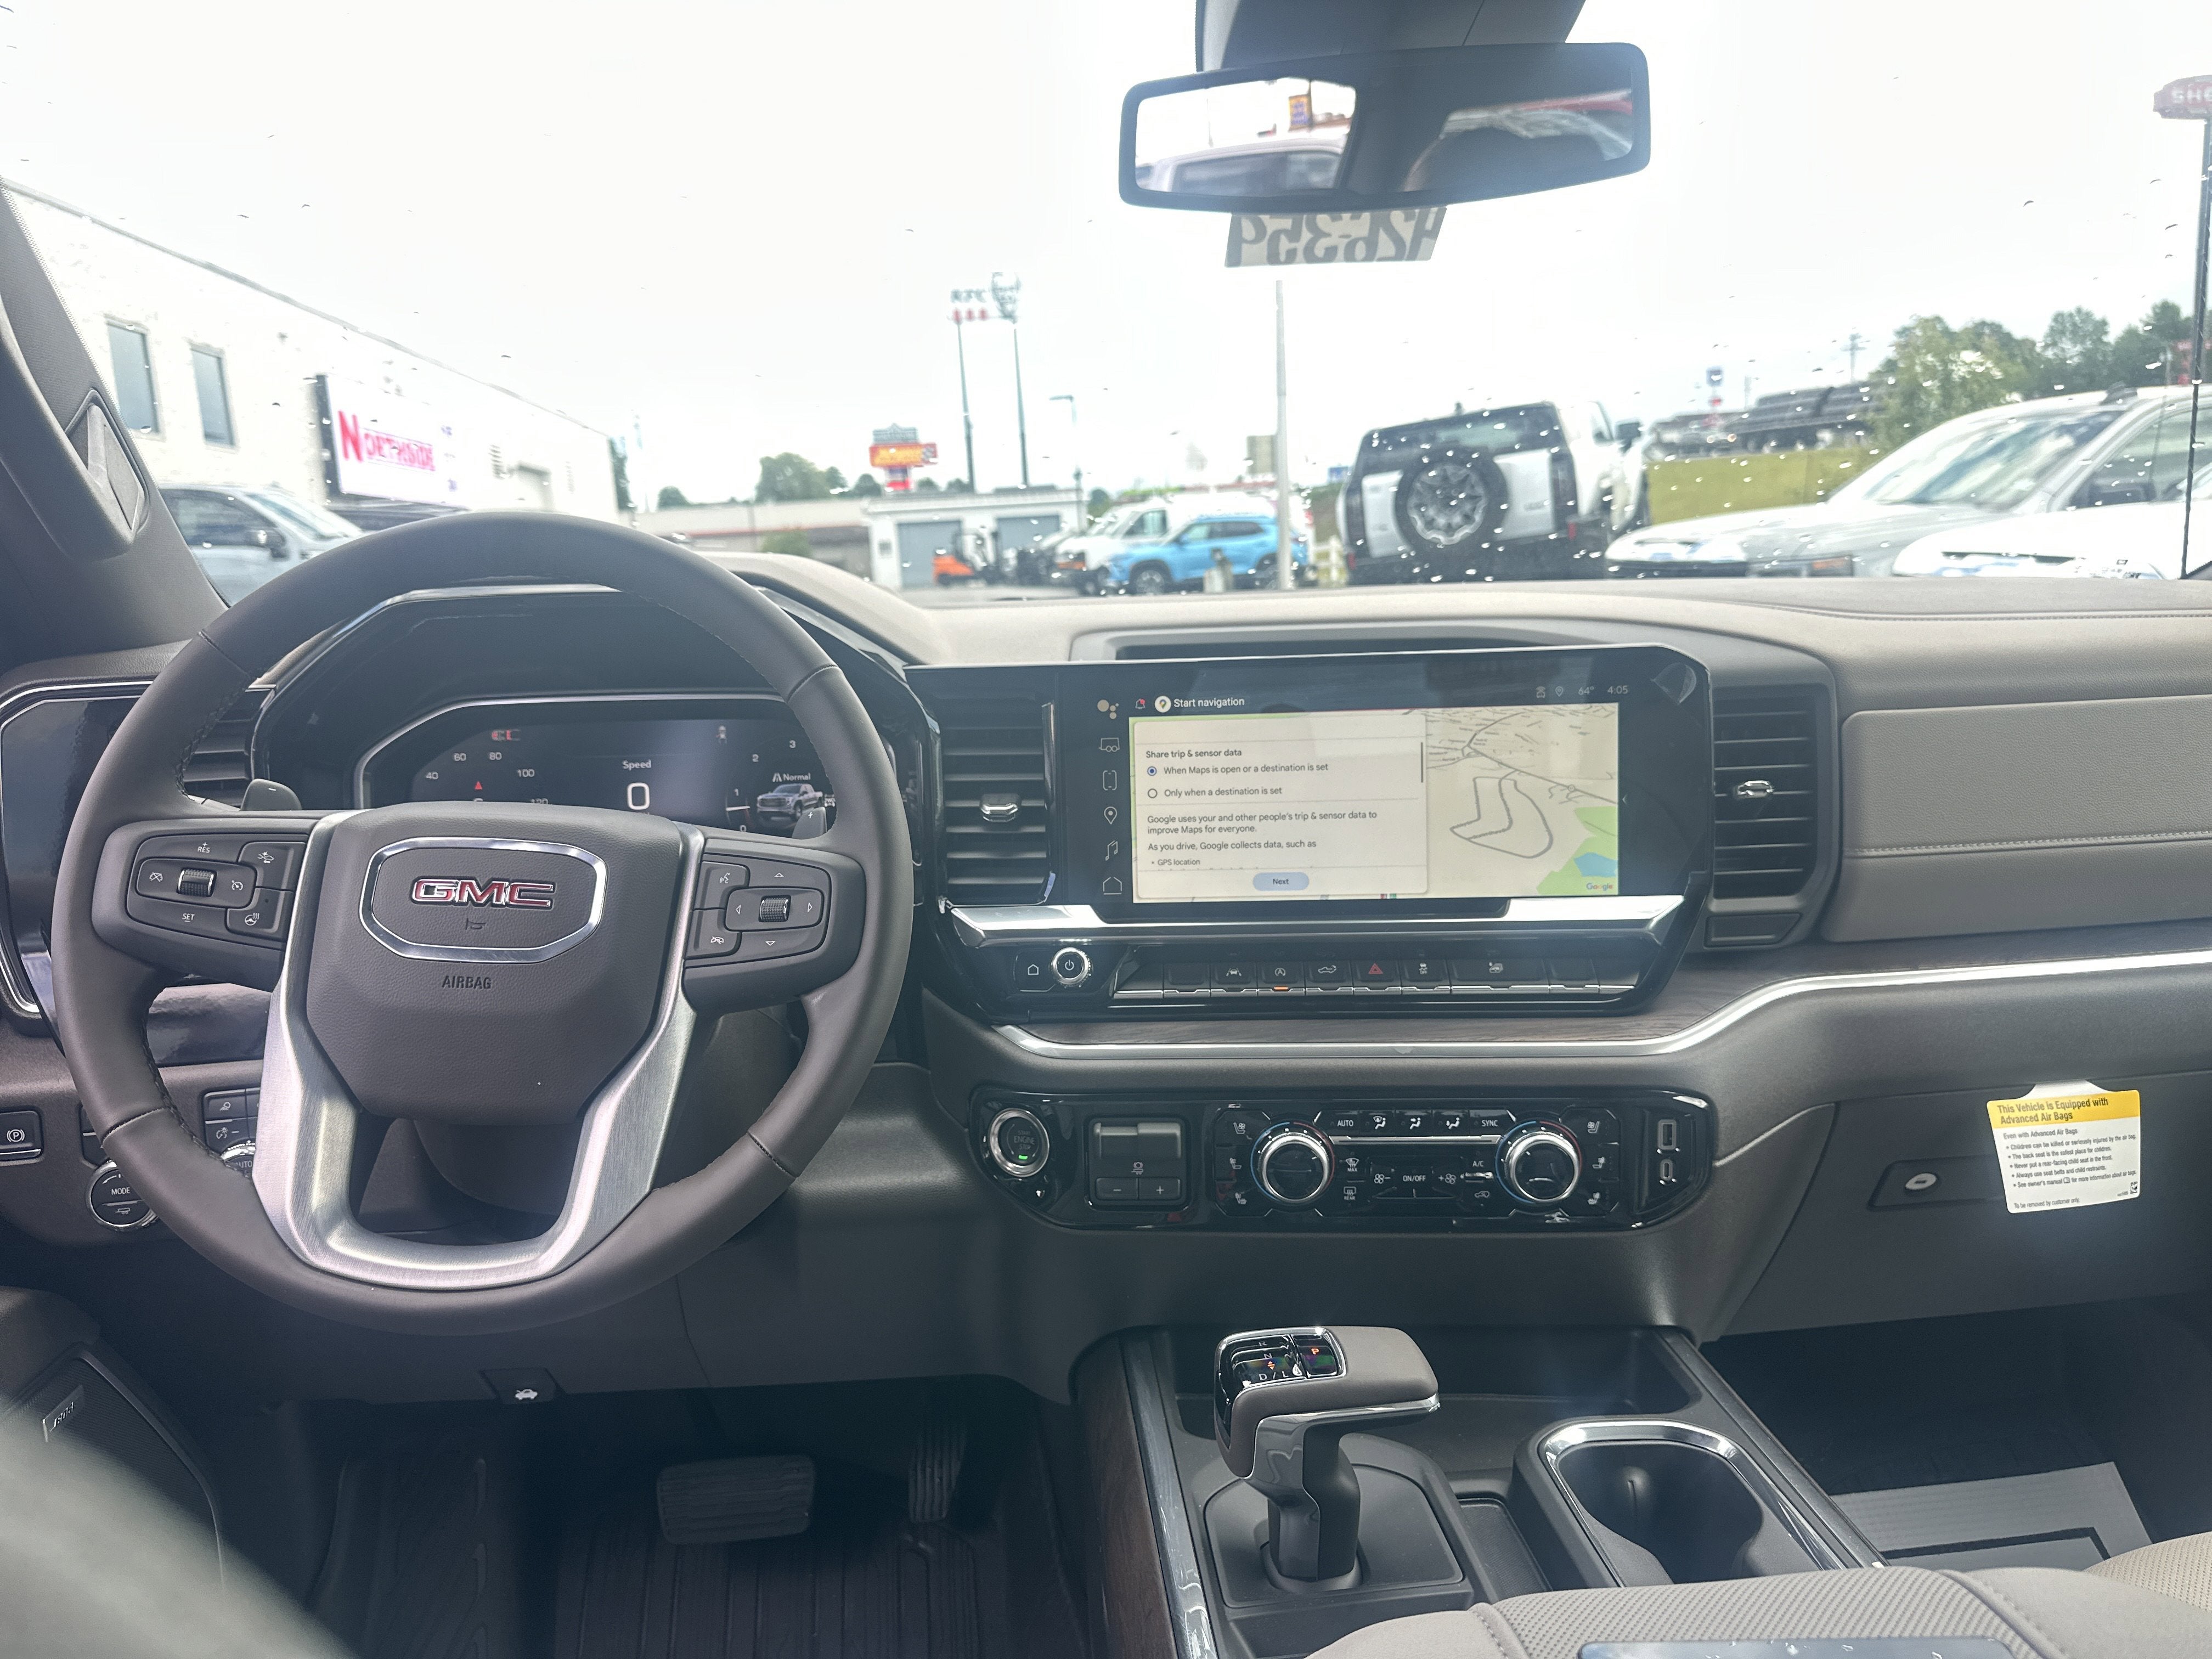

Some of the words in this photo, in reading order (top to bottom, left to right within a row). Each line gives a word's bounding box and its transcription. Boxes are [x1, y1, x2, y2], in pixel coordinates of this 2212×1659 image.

[1607, 685, 1628, 695] 4:05
[1174, 698, 1195, 708] Start
[1198, 697, 1245, 708] navigation
[789, 740, 795, 748] 3
[454, 753, 466, 761] 60
[752, 754, 759, 762] 2
[1171, 751, 1185, 759] trip
[622, 759, 652, 771] Speed
[1189, 766, 1210, 775] Maps
[1261, 764, 1305, 772] destination
[426, 771, 438, 780] 40
[517, 769, 535, 777] 100
[783, 773, 811, 781] Normal
[627, 782, 650, 810] 0
[1164, 788, 1182, 798] Only
[1215, 787, 1259, 795] destination
[1147, 815, 1176, 825] Google
[1198, 816, 1216, 824] your
[1295, 812, 1308, 821] trip
[1181, 826, 1203, 834] Maps
[1218, 826, 1257, 834] everyone.
[1176, 842, 1198, 851] drive,
[1200, 841, 1228, 851] Google
[1231, 840, 1262, 849] collects
[1264, 841, 1283, 849] data,
[1586, 882, 1613, 891] Google
[412, 878, 554, 908] GMC
[442, 975, 492, 989] AIRBAG
[1997, 1104, 2015, 1113] This
[2016, 1102, 2045, 1112] Vehicle
[2046, 1101, 2053, 1110] is
[2055, 1099, 2091, 1110] Equipped
[2092, 1097, 2108, 1107] with
[2001, 1114, 2039, 1124] Advanced
[2041, 1113, 2052, 1121] Air
[2053, 1112, 2073, 1121] Bags
[1014, 1136, 1035, 1145] ENGINE
